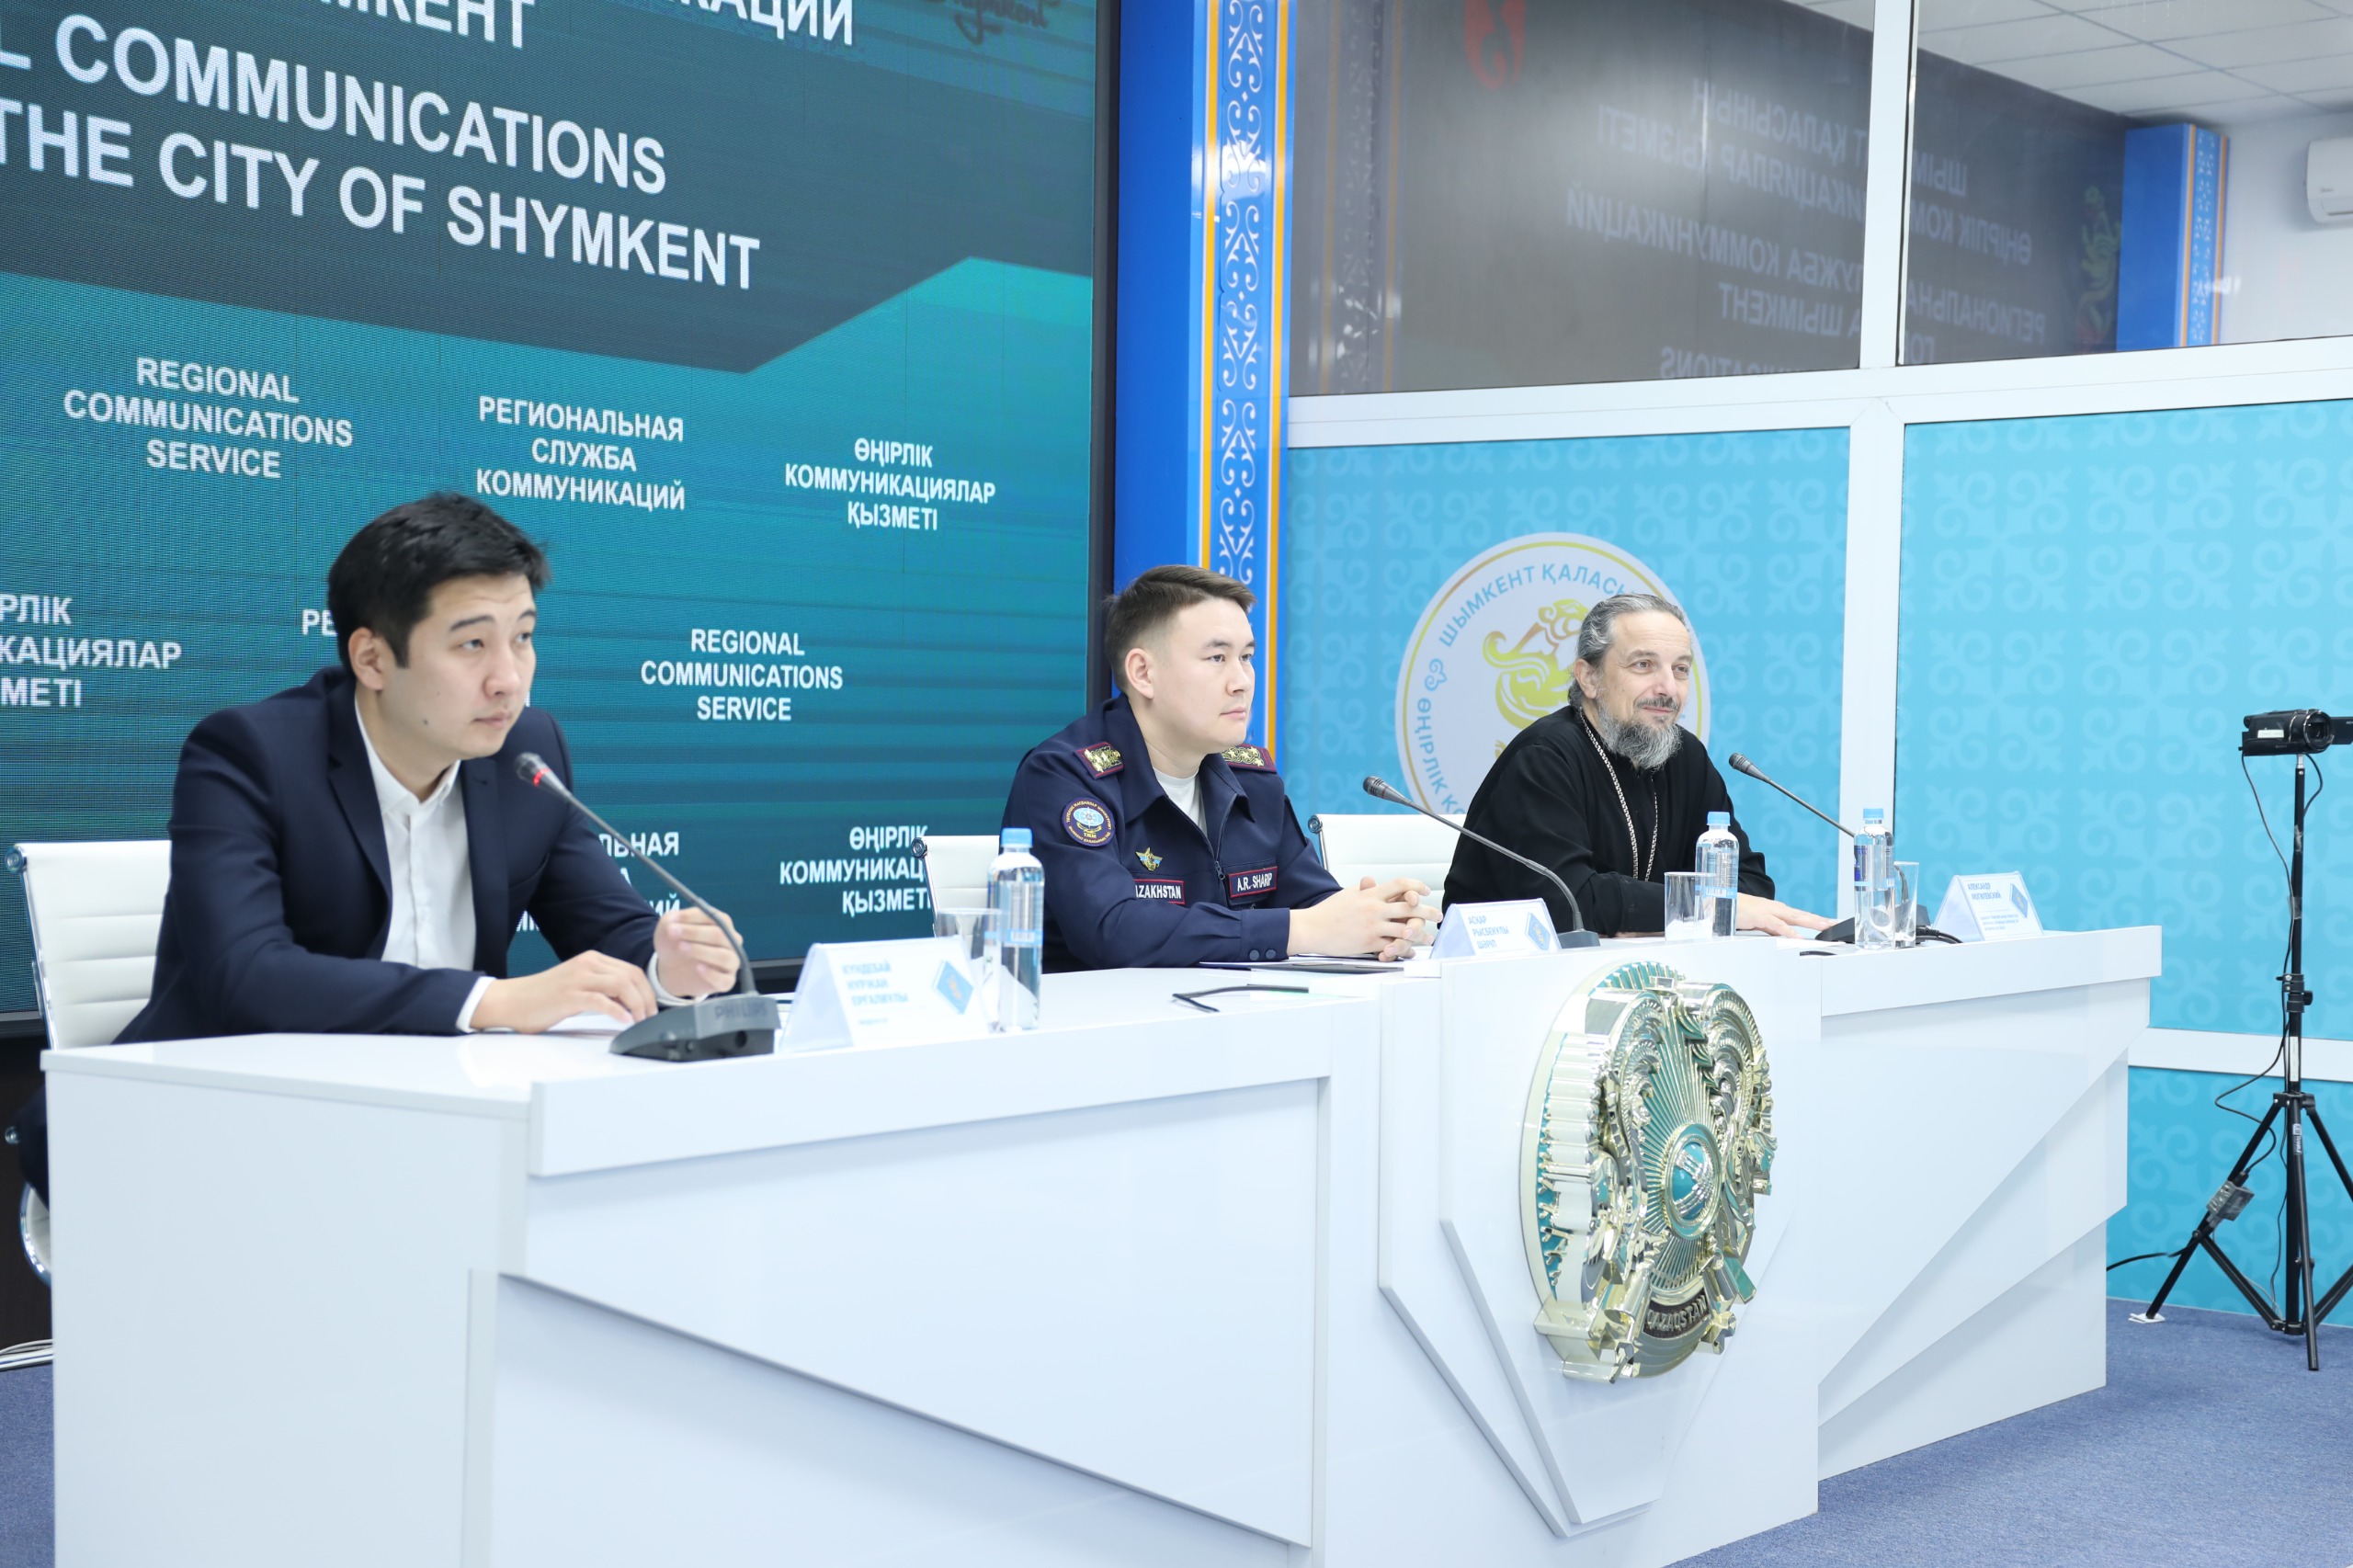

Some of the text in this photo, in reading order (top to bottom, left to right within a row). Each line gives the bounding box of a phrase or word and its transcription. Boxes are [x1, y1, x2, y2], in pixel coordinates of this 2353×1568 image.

[56, 14, 666, 194] COMMUNICATIONS
[0, 97, 760, 290] THE CITY OF SHYMKENT
[136, 357, 300, 403] REGIONAL
[63, 389, 354, 448] COMMUNICATIONS
[479, 395, 684, 442] РЕГИОНАЛЬНАЯ
[146, 439, 281, 479] SERVICE
[531, 437, 637, 472] СЛУЖБА
[854, 437, 933, 468] ӨҢІРЛІК
[476, 468, 685, 512] КОММУНИКАЦИЙ
[785, 463, 995, 504] КОММУНИКАЦИЯЛАР
[847, 501, 938, 531] ҚЫЗМЕТІ
[1439, 565, 1535, 648] ШЫМКЕНТ
[691, 629, 805, 656] REGIONAL
[641, 660, 843, 689] COMMUNICATIONS
[697, 696, 791, 721] SERVICE
[1415, 698, 1448, 794] ӨҢІРЛІК
[779, 857, 925, 884] КОММУНИКАЦ
